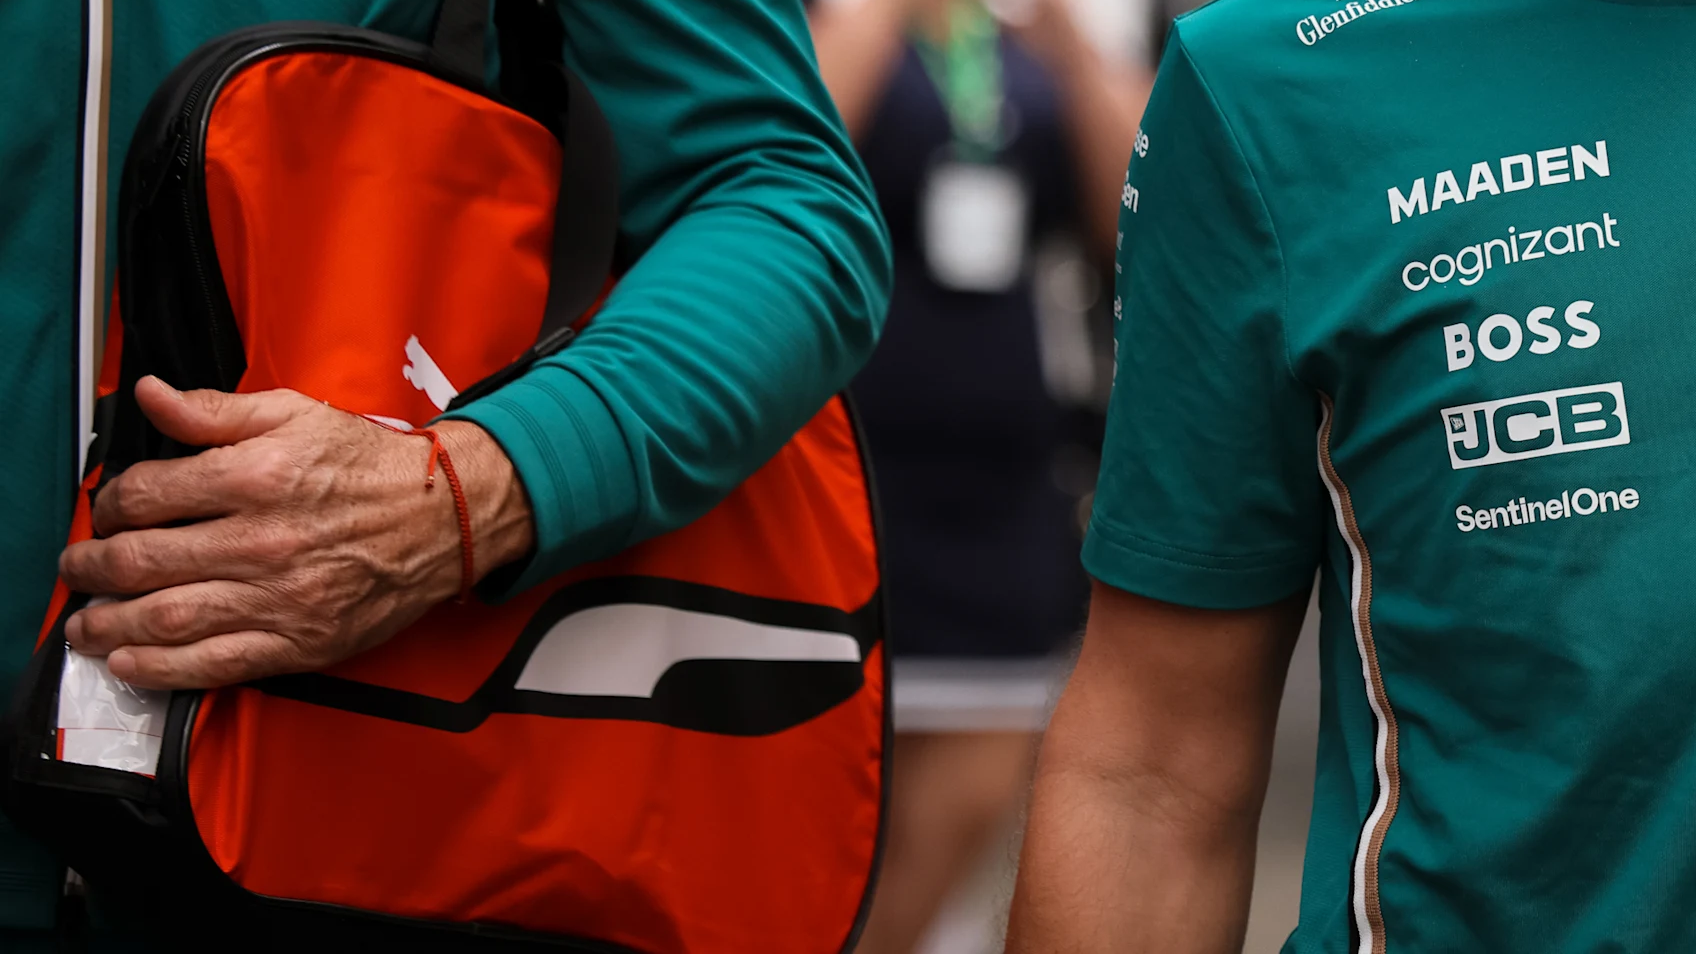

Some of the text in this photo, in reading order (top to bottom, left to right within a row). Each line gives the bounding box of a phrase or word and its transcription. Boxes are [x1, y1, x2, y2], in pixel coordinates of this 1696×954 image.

[1387, 140, 1610, 225] MAADEN
[1402, 212, 1620, 291] cognizant
[1443, 300, 1601, 372] BOSS
[1448, 390, 1623, 462] JCB
[1455, 487, 1640, 532] SentinelOne
